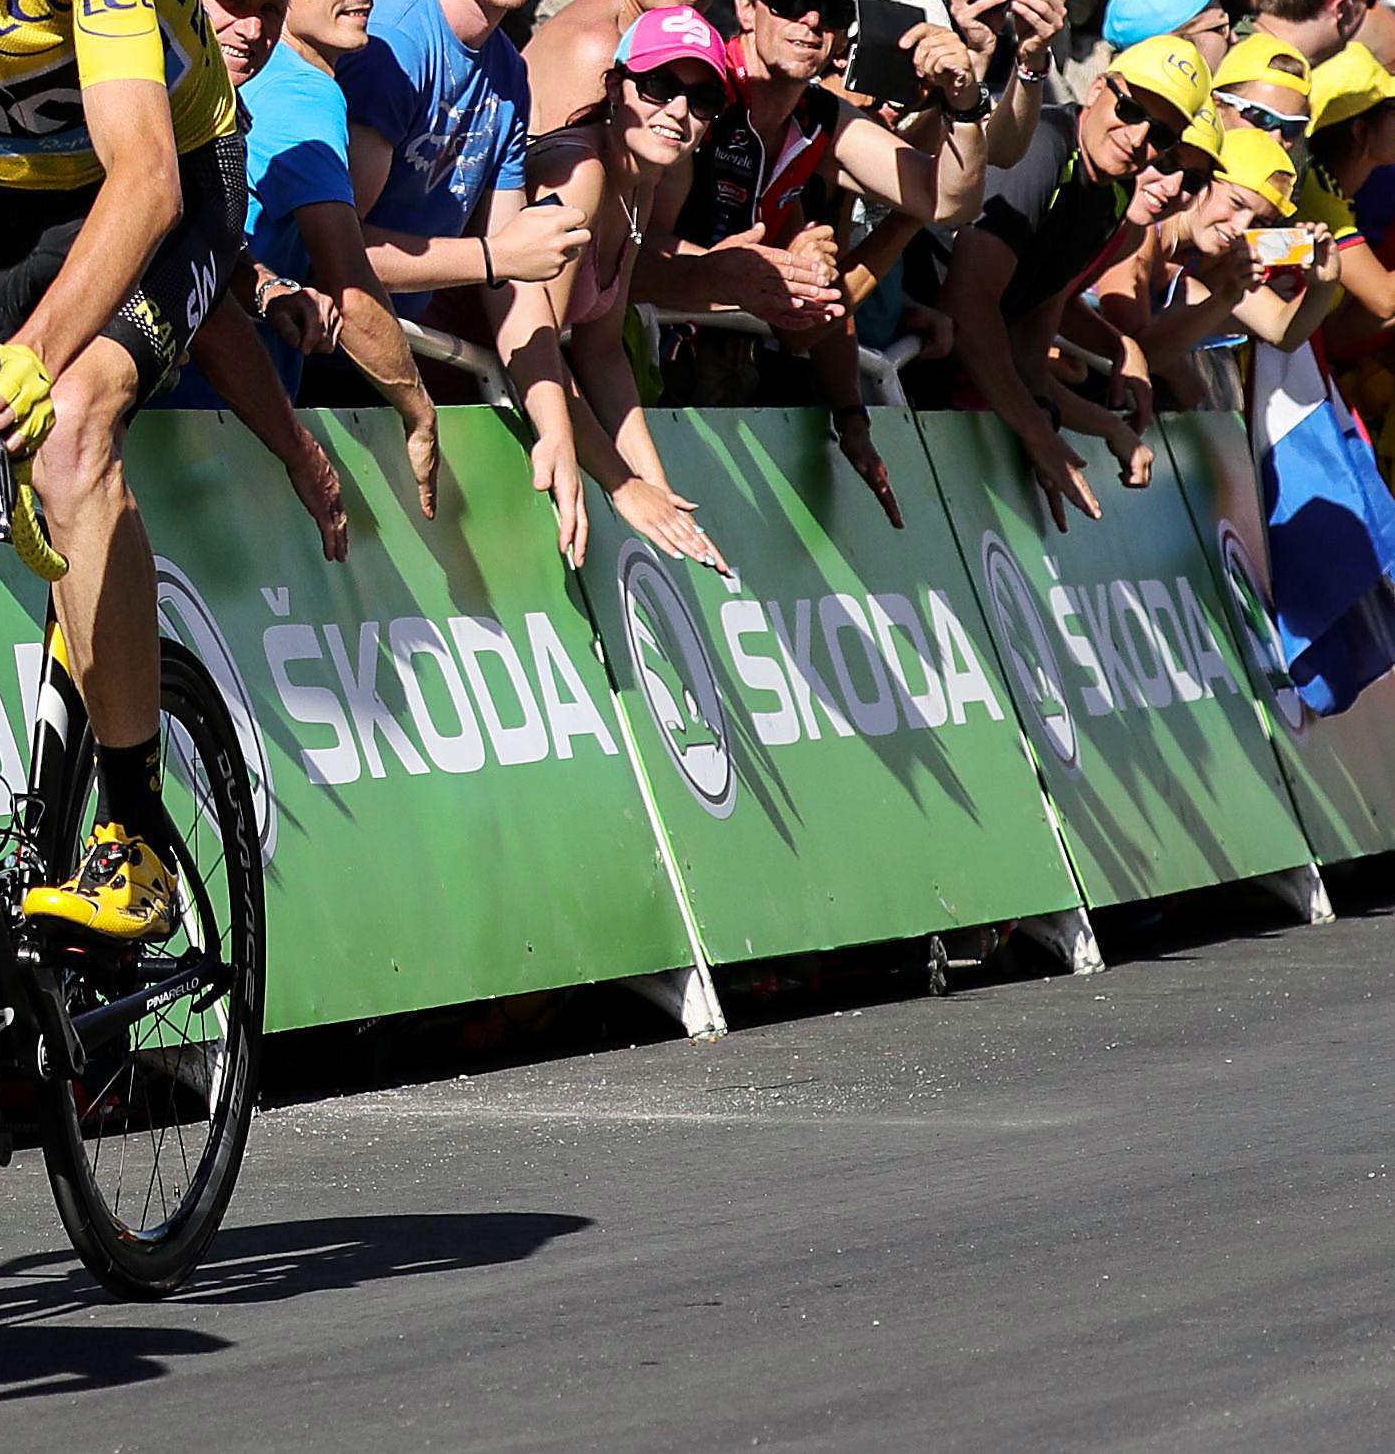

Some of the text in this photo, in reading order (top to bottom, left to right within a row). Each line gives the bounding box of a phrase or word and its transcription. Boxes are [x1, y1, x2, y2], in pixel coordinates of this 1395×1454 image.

[262, 586, 620, 785] ŠKODA
[721, 567, 1005, 747] ŠKODA
[1045, 555, 1240, 717] ŠKODA
[145, 976, 200, 1011] PINARELLO
